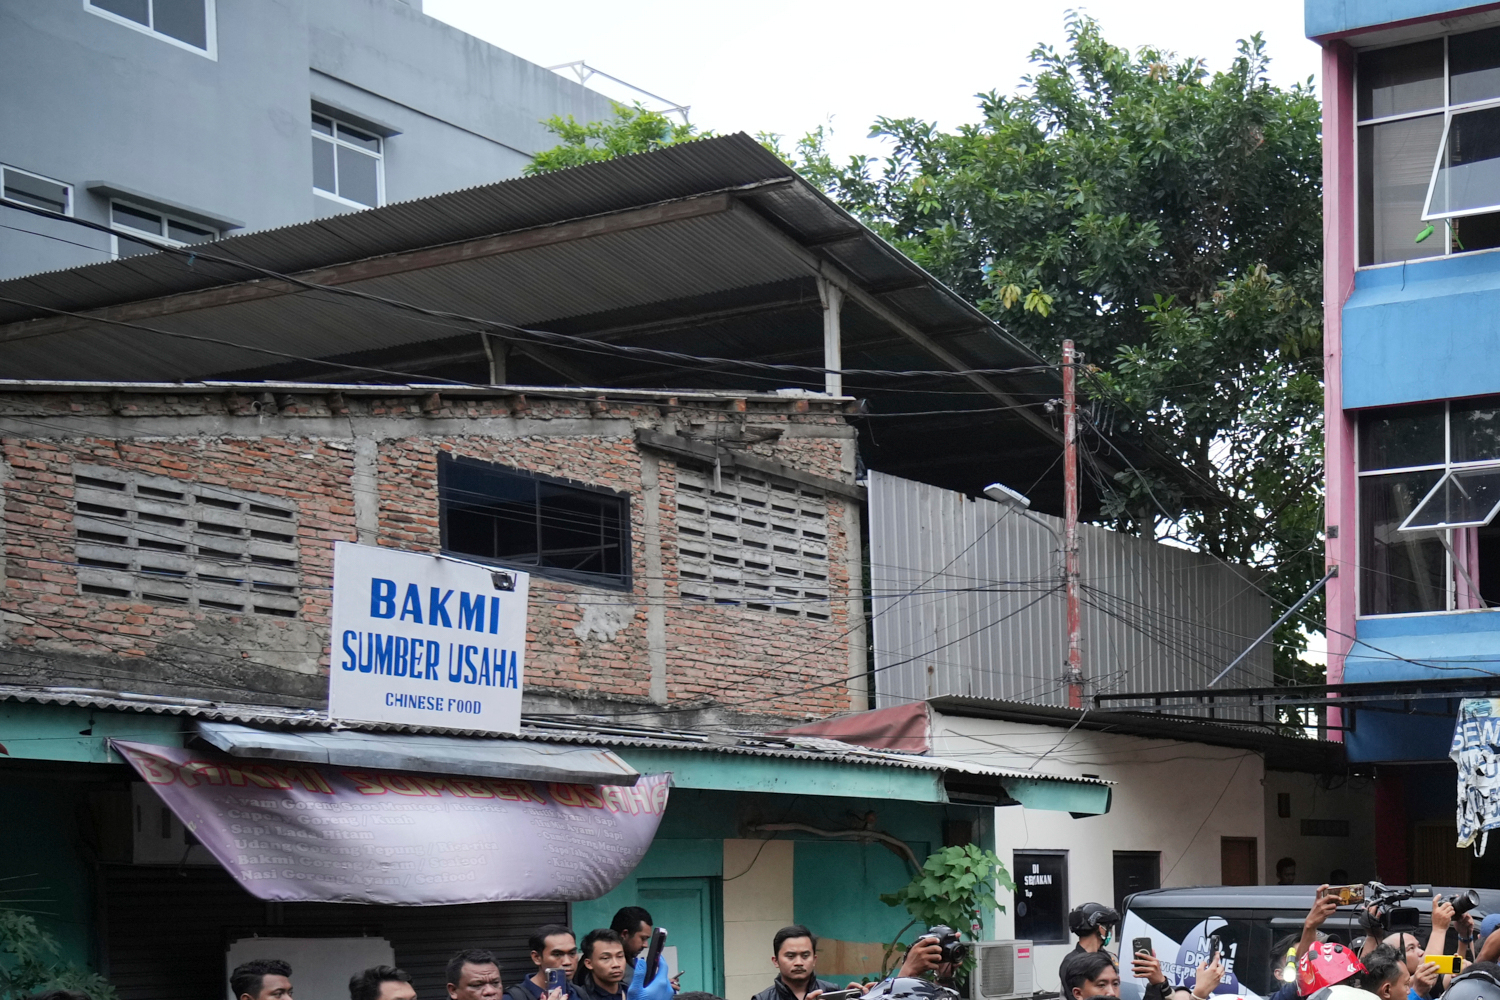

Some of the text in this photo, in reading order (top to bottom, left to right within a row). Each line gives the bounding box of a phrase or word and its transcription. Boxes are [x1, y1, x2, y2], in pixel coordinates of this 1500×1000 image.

[370, 577, 500, 635] BAKMI
[342, 629, 518, 689] SUMBER USAHA
[385, 692, 482, 715] CHINESE FOOD
[128, 749, 669, 817] BAKMI SUMBER USAHA
[281, 800, 341, 812] Goreng
[297, 814, 360, 826] Goreng
[322, 830, 374, 840] Hitam
[238, 854, 295, 866] Bakmi
[242, 869, 278, 881] Nasi
[1032, 864, 1039, 874] DI
